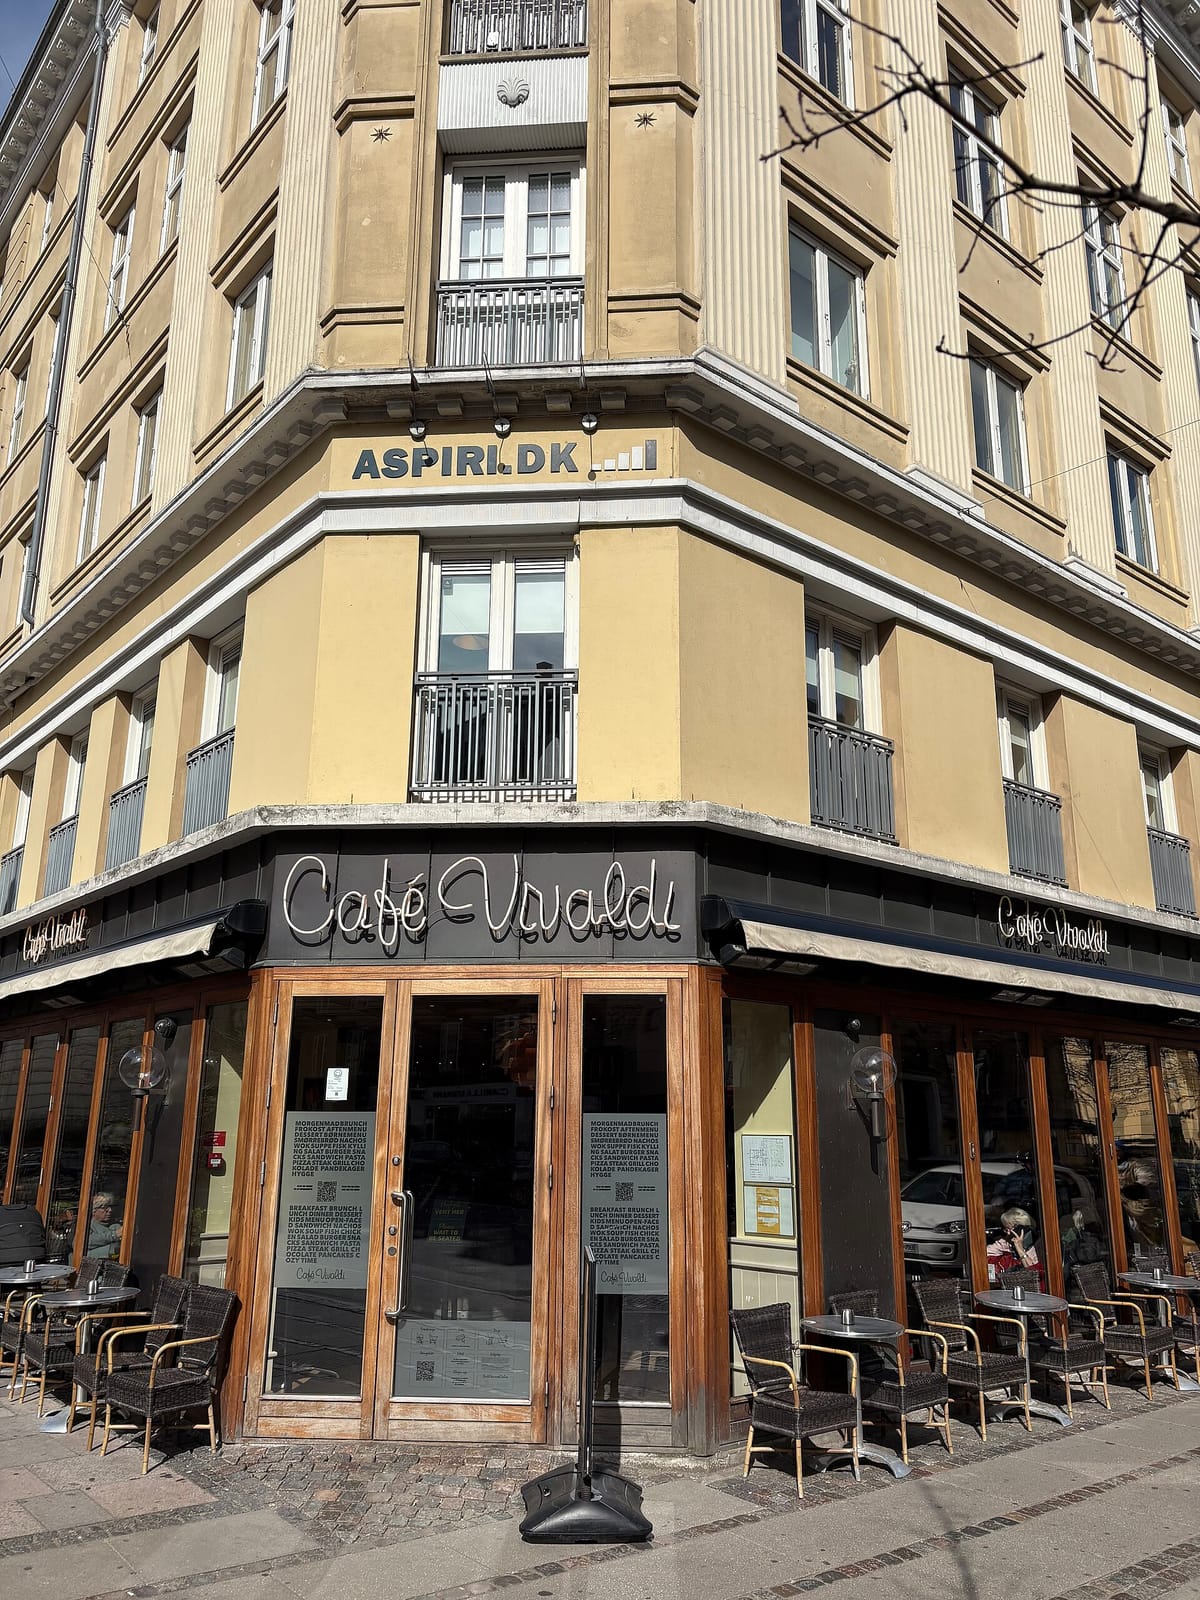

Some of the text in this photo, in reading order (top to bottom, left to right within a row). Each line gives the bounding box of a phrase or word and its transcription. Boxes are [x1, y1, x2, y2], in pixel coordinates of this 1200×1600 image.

[352, 442, 579, 480] ASPIRI.DK
[284, 854, 681, 946] Café Vivaldi
[998, 896, 1110, 954] Café Vivaldi
